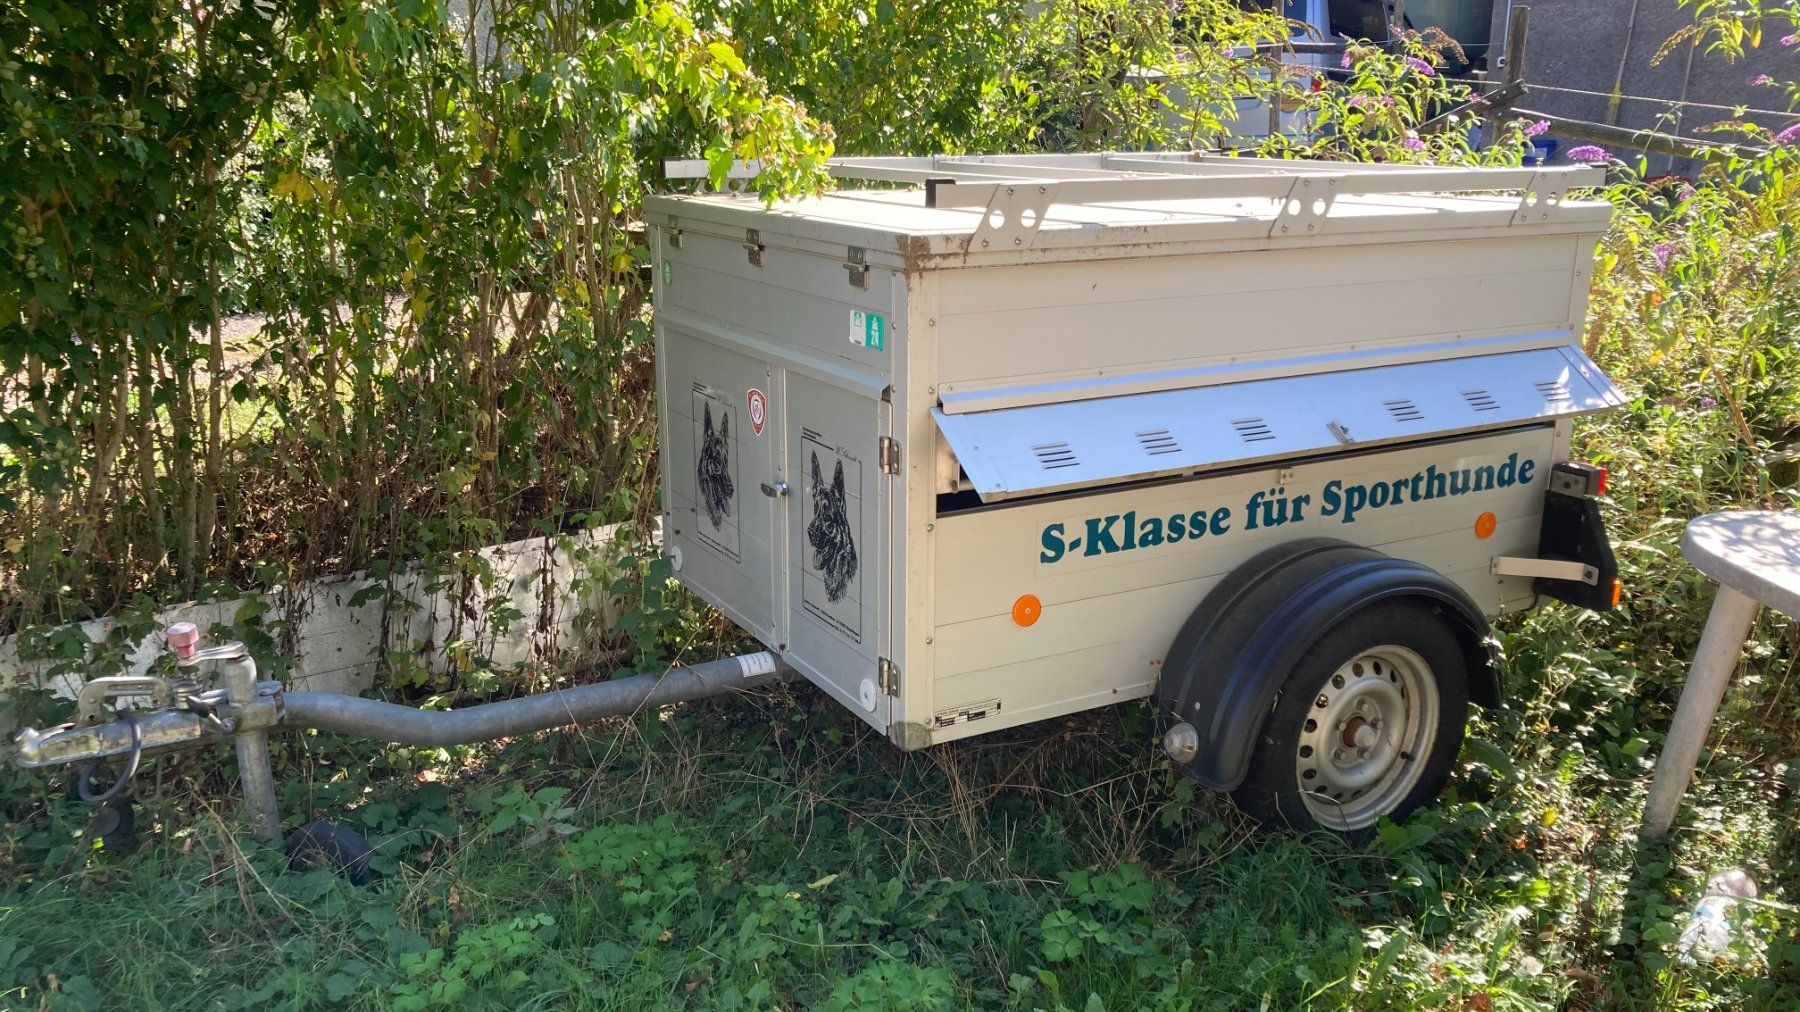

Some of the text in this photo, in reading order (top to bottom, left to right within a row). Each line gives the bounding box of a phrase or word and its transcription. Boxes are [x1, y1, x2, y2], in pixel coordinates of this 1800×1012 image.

[1040, 452, 1535, 564] S-Klasse für Sporthunde
